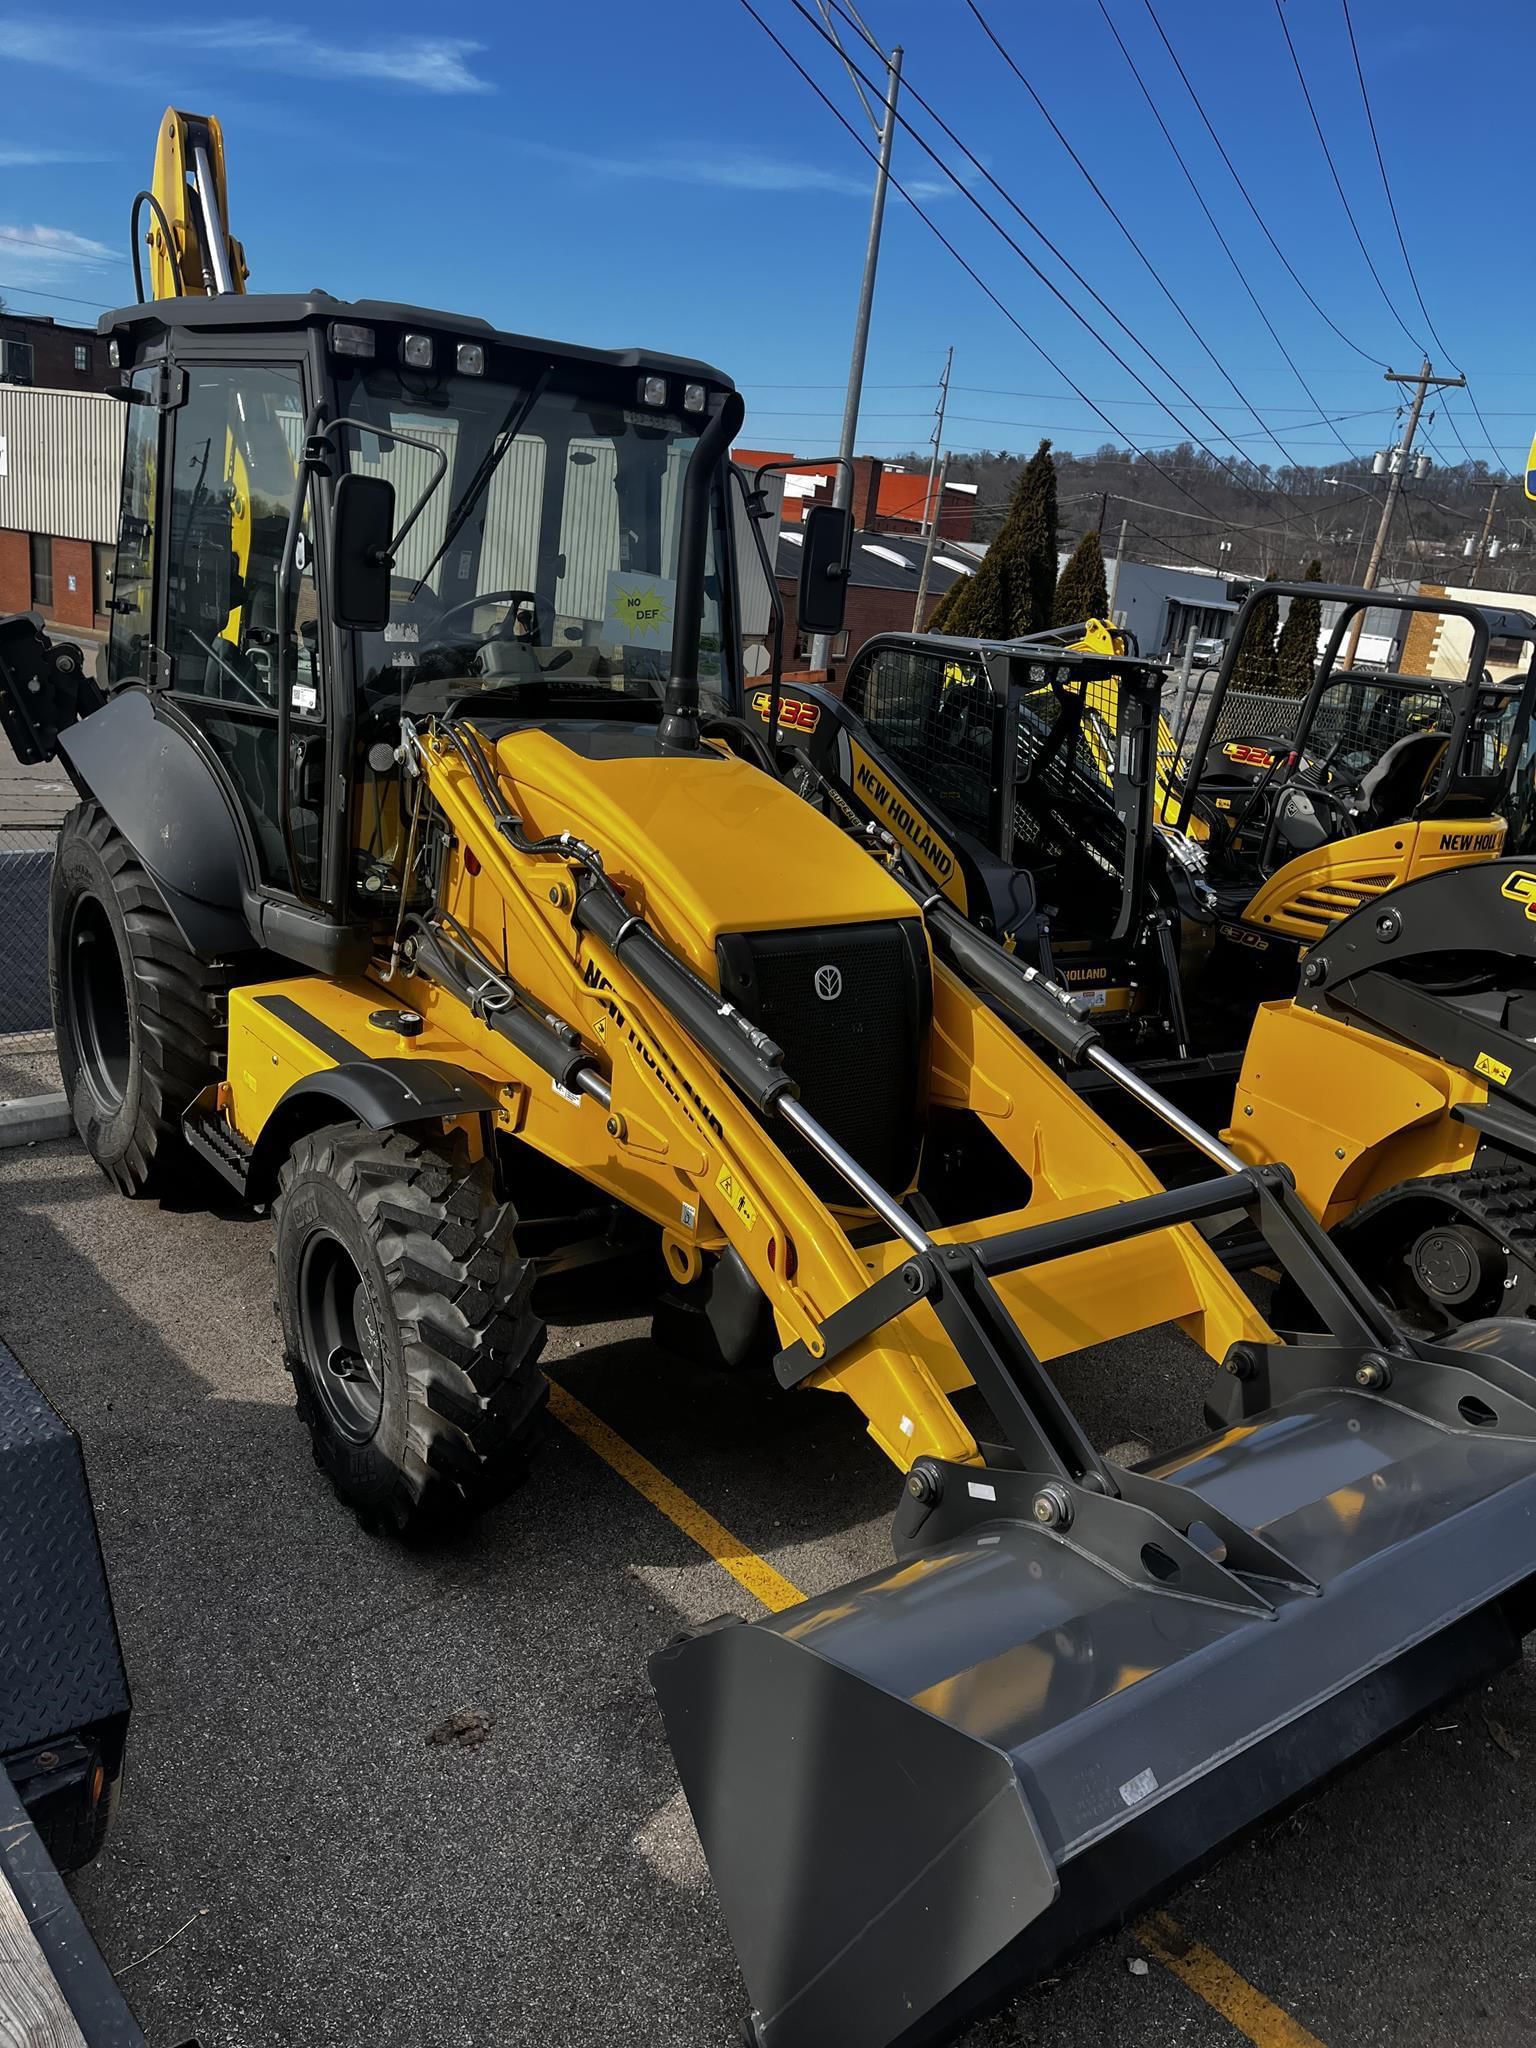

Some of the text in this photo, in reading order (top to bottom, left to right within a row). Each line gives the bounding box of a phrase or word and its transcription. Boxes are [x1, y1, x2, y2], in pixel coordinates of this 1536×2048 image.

[627, 598, 641, 607] NO
[636, 609, 660, 620] DEF
[857, 763, 951, 876] NEW HOLLAND
[1440, 834, 1473, 850] NEW
